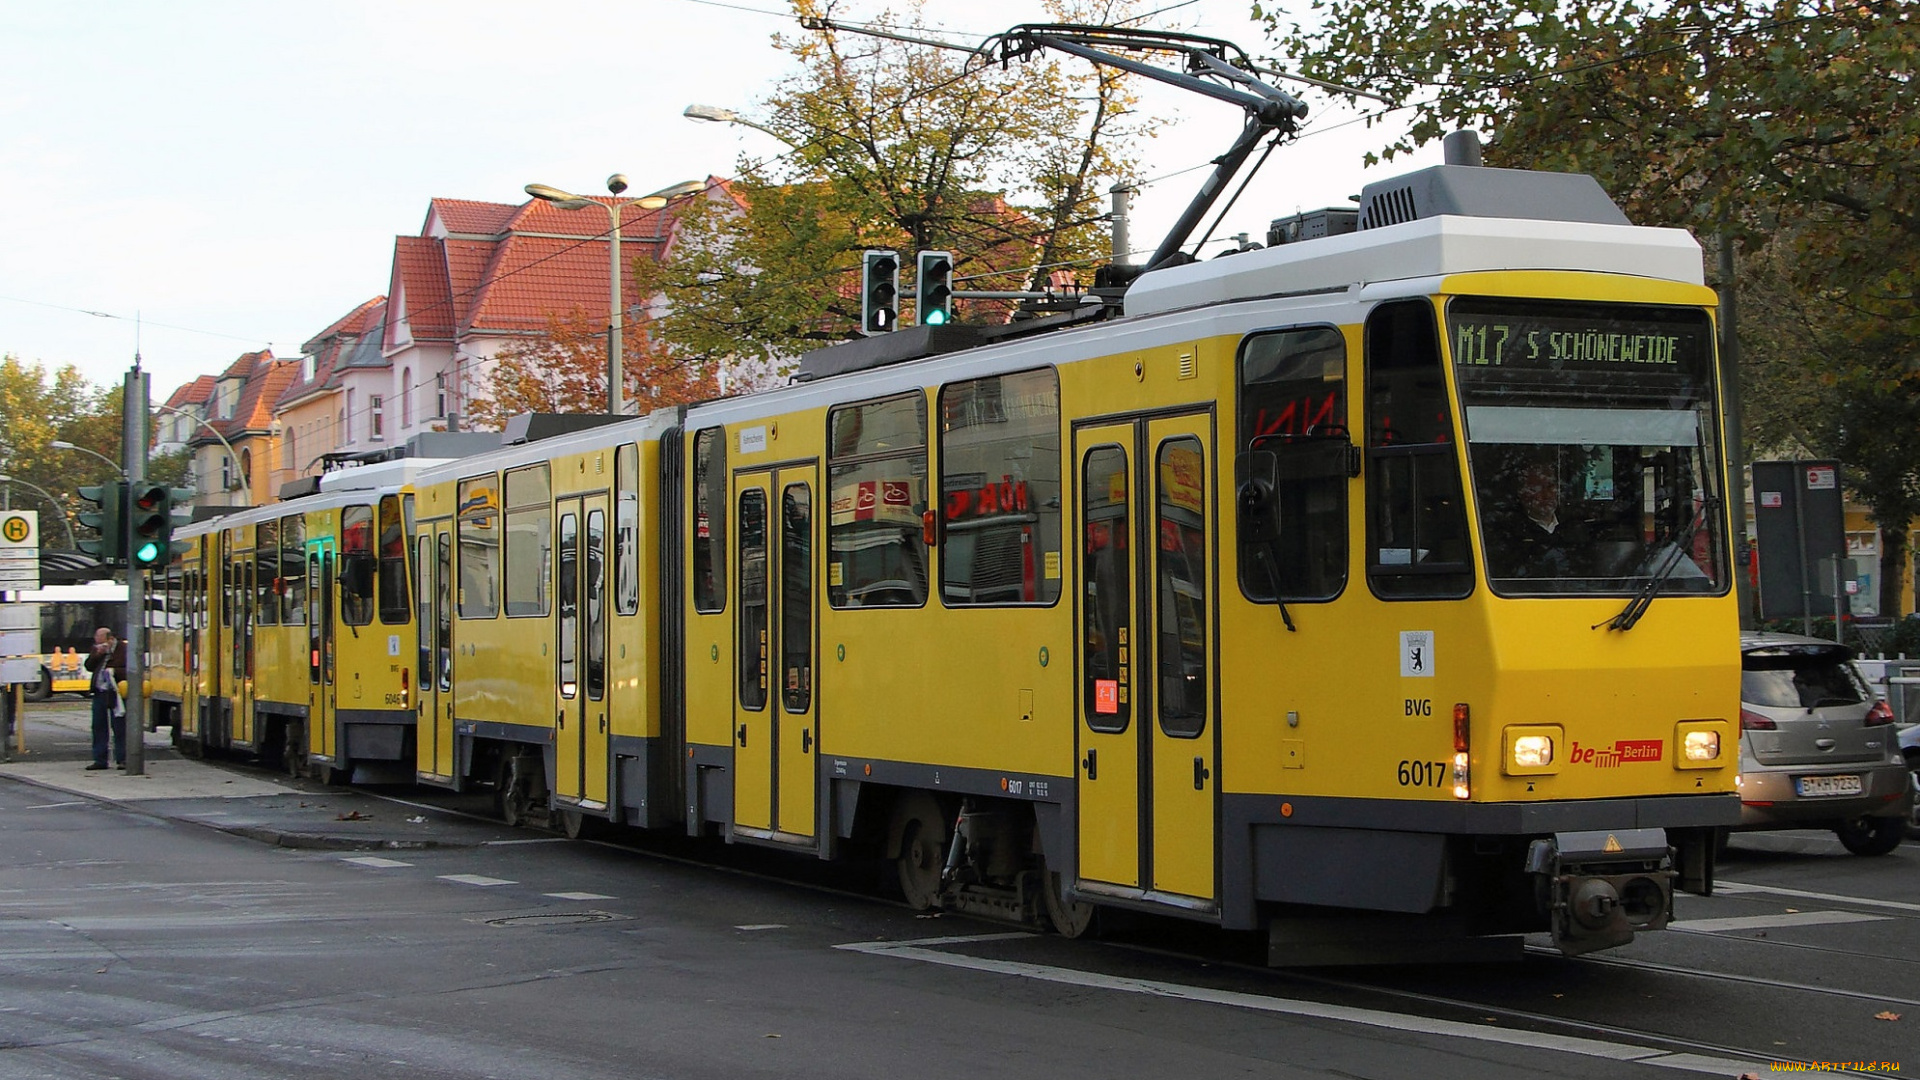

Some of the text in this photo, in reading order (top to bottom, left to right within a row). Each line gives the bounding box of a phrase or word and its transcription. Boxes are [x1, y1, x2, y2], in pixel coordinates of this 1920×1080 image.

[1457, 324, 1679, 365] M17 S SCHÖNEWEIDE
[9, 521, 24, 537] H
[385, 693, 401, 705] 6046
[1405, 699, 1431, 716] BVG
[1623, 745, 1658, 758] Berlin
[1398, 760, 1446, 788] 6017
[1008, 780, 1022, 794] 6017
